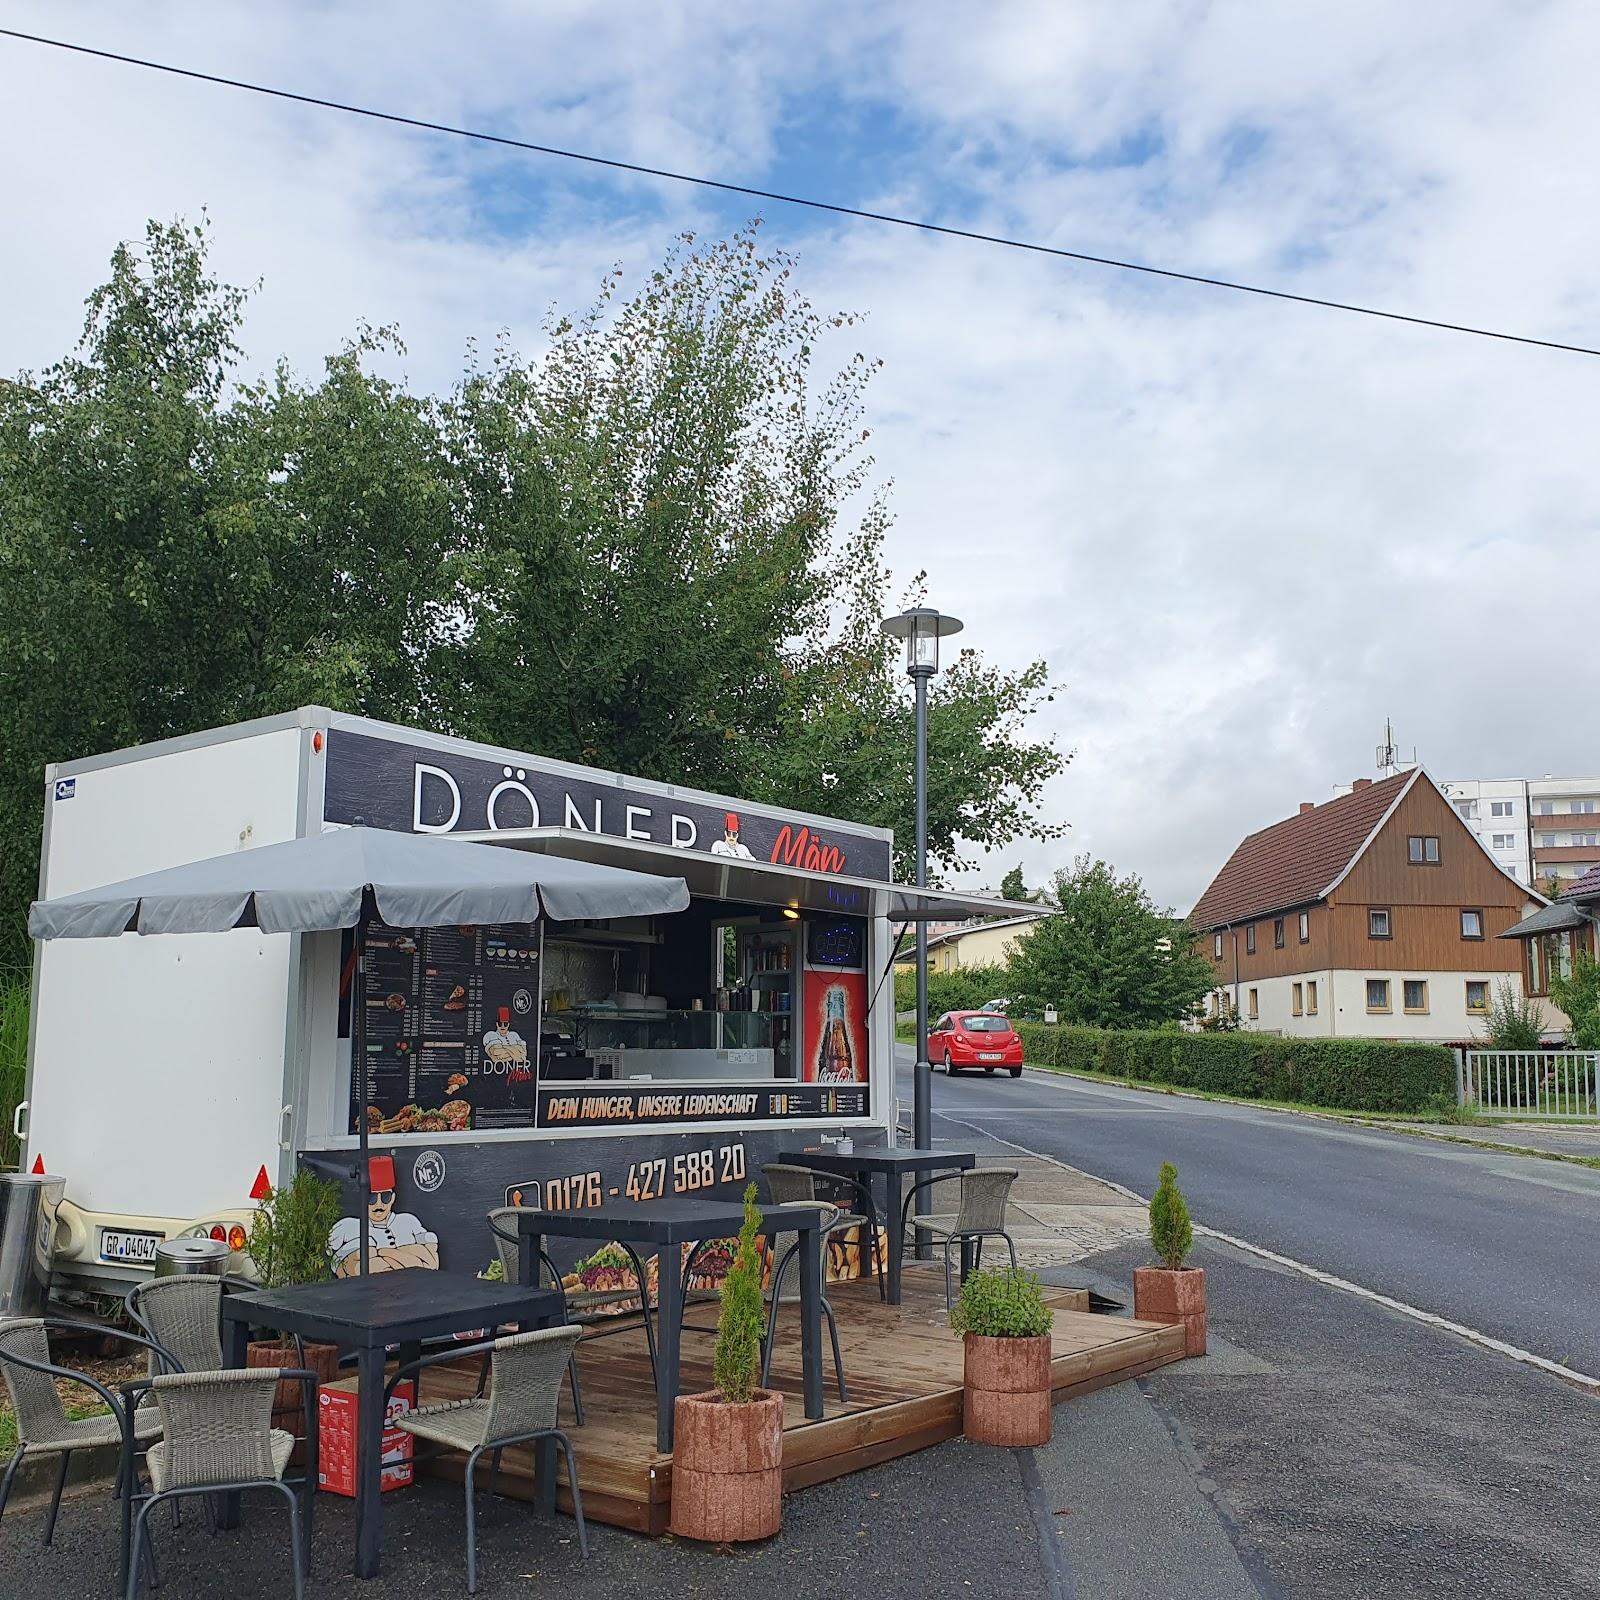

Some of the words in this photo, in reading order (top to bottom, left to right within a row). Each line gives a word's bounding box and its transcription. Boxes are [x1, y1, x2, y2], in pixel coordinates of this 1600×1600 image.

[413, 763, 697, 849] DÖNER
[770, 824, 846, 873] Män
[547, 1097, 579, 1120] DEIN
[581, 1096, 634, 1120] HUNGER,
[637, 1095, 682, 1117] UNSERE
[683, 1094, 758, 1115] LEIDENSCHAFT
[546, 1171, 602, 1211] 0176
[625, 1159, 666, 1202] 427
[673, 1150, 714, 1193] 588
[720, 1143, 746, 1183] 20
[106, 1235, 119, 1255] GR
[125, 1237, 155, 1258] 04047
